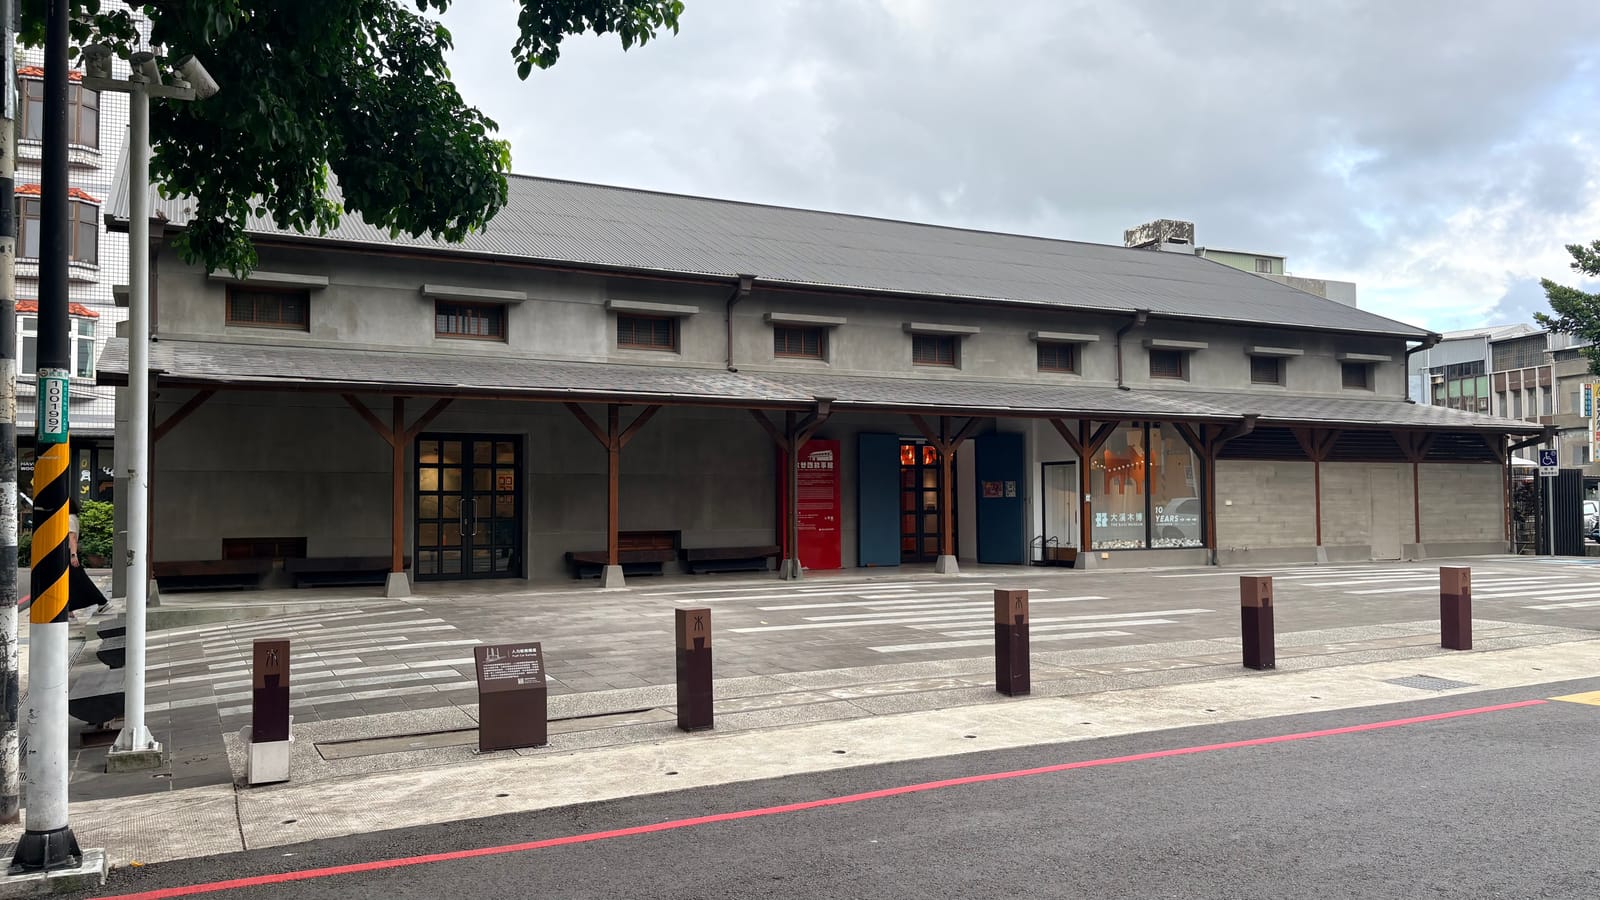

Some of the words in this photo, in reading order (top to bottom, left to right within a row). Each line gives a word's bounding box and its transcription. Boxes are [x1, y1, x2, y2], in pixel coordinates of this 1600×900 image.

[48, 381, 60, 432] 1001997
[1155, 506, 1163, 514] 10
[1155, 515, 1179, 523] YEARS
